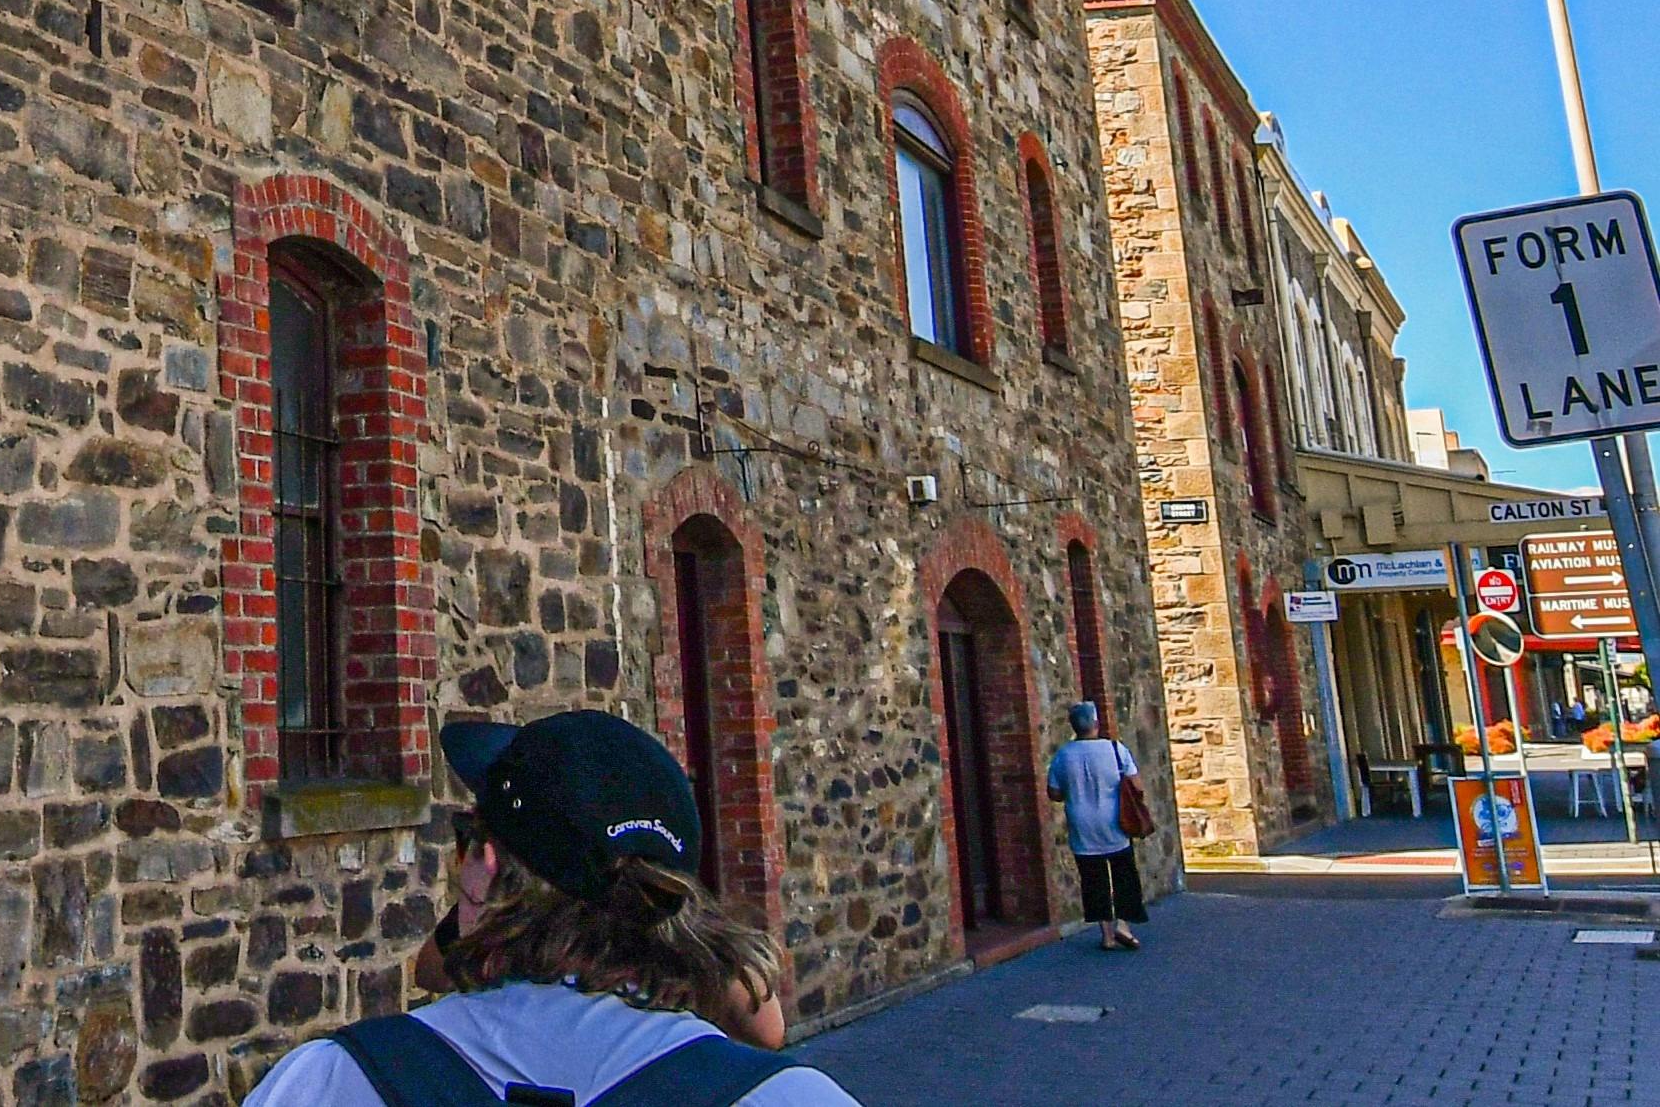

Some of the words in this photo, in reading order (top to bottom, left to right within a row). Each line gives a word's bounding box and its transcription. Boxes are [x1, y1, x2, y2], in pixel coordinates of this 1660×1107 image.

[1481, 218, 1627, 275] FORM
[1549, 282, 1590, 357] 1
[1519, 364, 1660, 421] LANE
[1490, 502, 1564, 521] CALTON
[1571, 499, 1592, 515] ST
[1528, 541, 1586, 555] RAILWAY
[1530, 557, 1592, 570] AVIATION
[1484, 596, 1512, 606] ENTRY
[1540, 598, 1599, 612] MARITIME
[606, 819, 653, 837] Caravan
